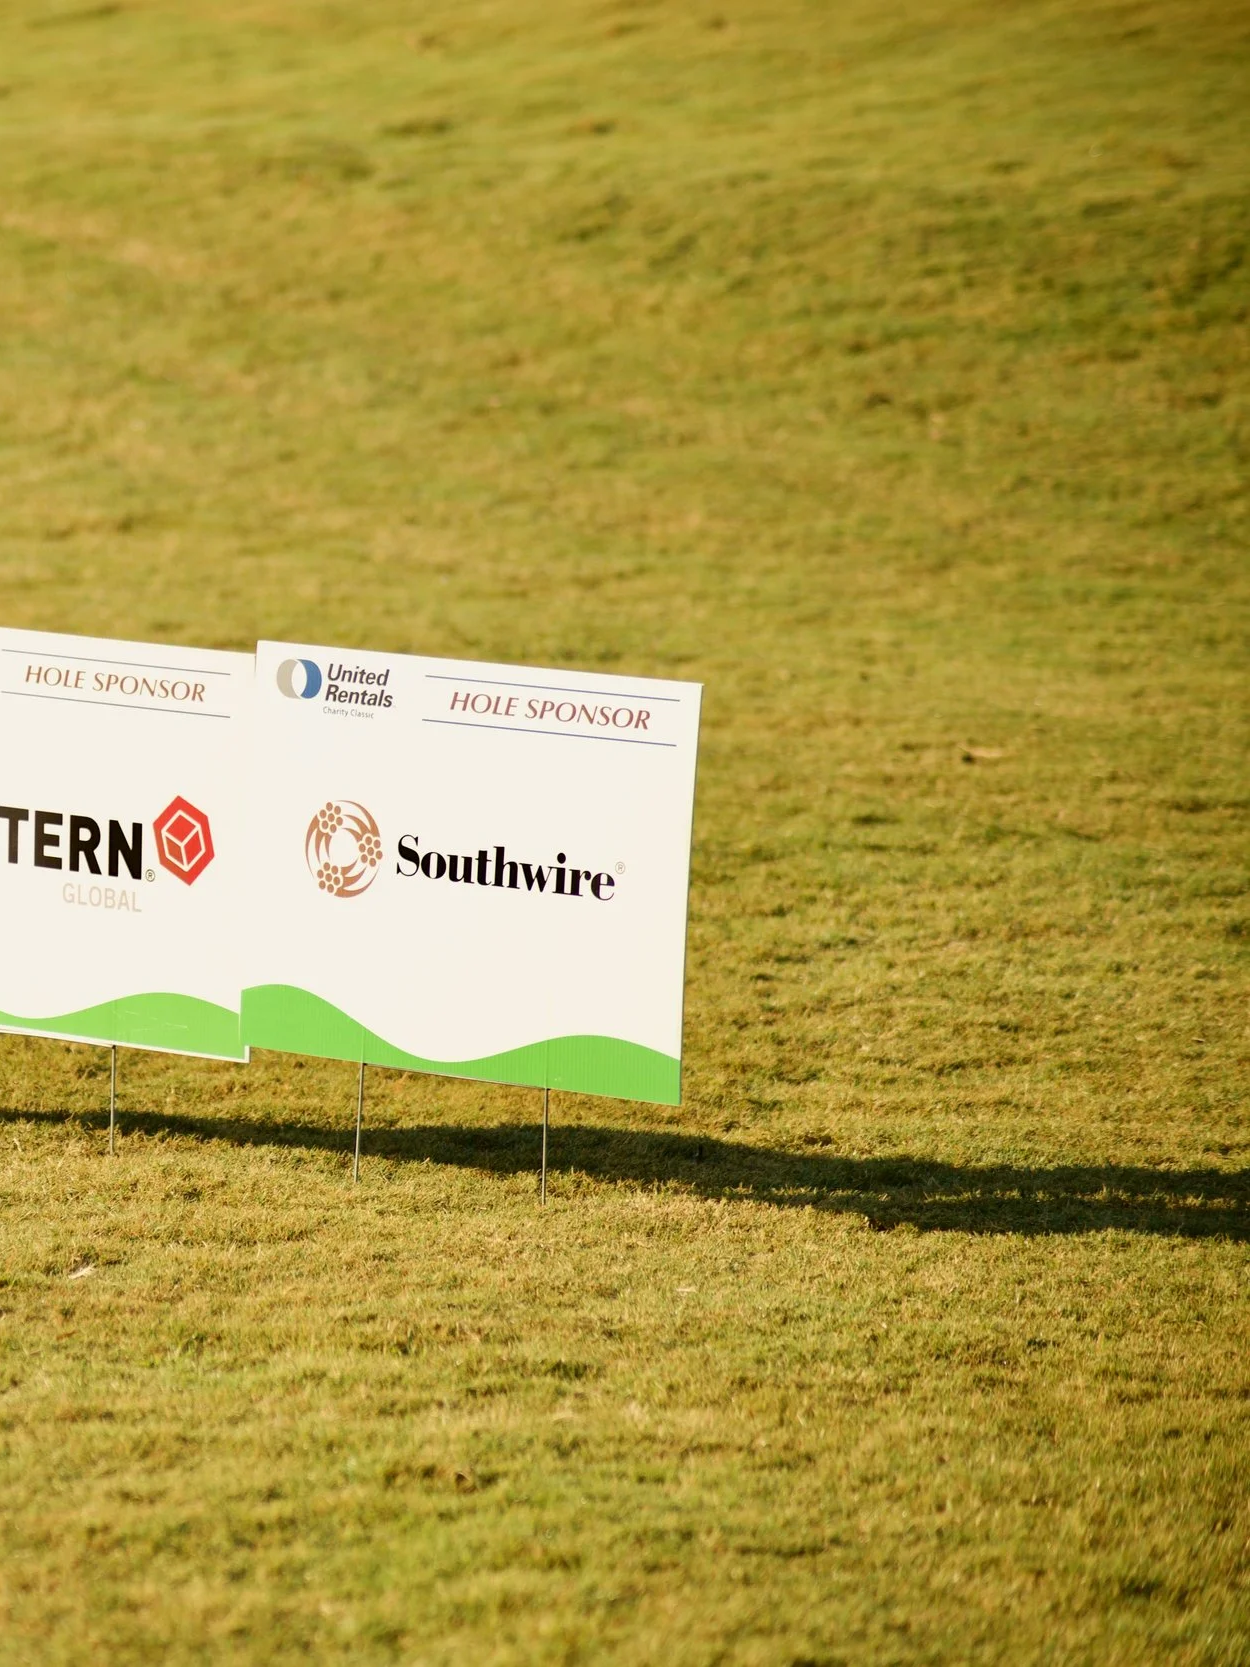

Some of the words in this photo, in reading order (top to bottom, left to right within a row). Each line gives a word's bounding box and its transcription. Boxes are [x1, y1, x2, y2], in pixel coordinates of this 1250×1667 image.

[25, 665, 86, 688] HOLE
[92, 672, 205, 702] SPONSOR
[327, 663, 390, 686] United
[325, 684, 393, 708] Rentals
[322, 706, 348, 718] Charity
[350, 709, 374, 719] Classic
[450, 692, 519, 718] HOLE
[525, 699, 651, 730] SPONSOR
[396, 834, 615, 901] Southwire
[62, 883, 142, 912] GLOBAL
